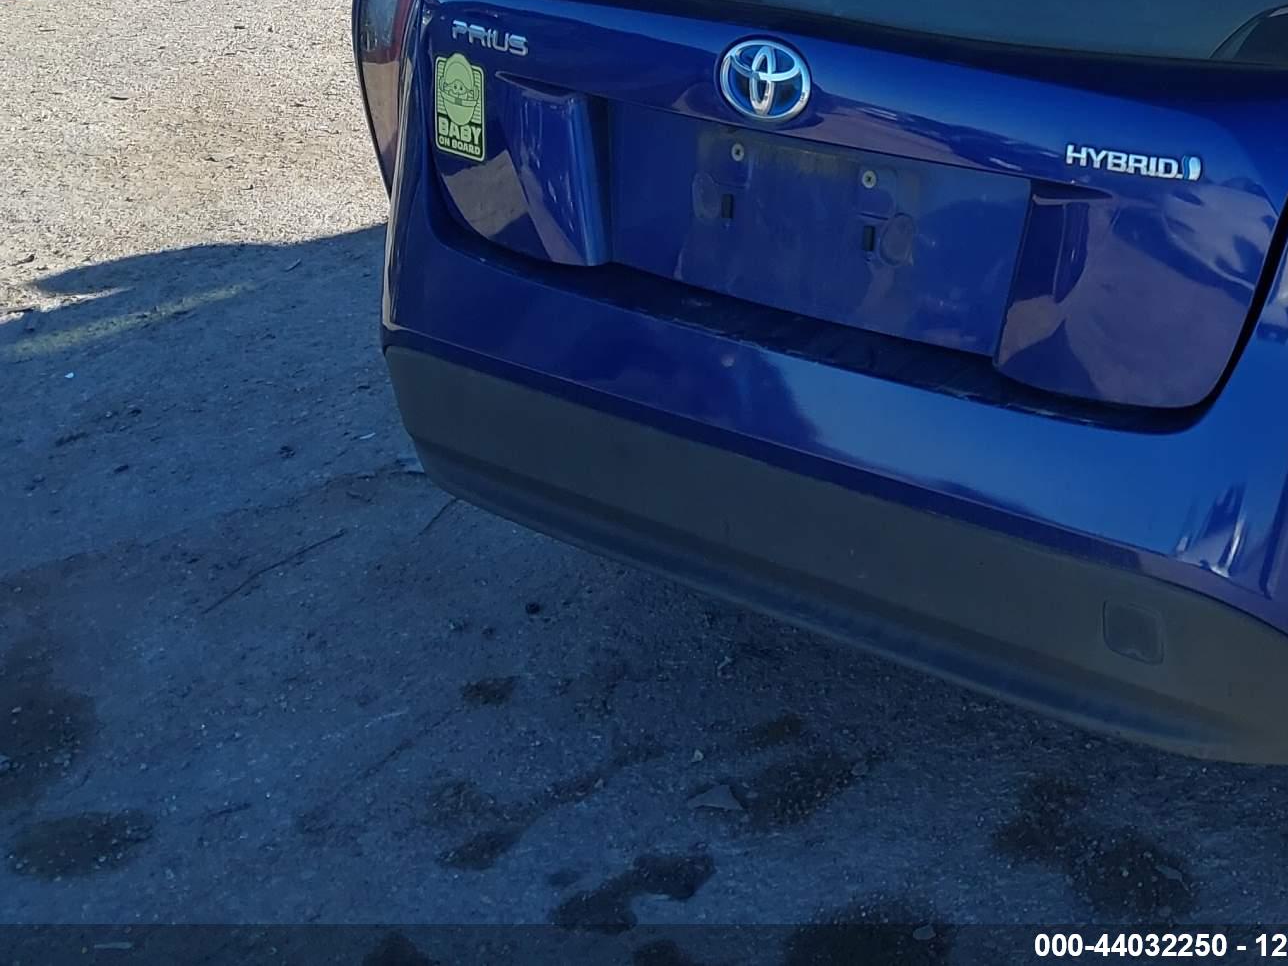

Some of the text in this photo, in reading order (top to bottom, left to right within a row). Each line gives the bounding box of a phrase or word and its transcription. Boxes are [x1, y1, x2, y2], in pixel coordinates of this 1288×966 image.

[452, 19, 529, 56] PRIUS
[438, 116, 482, 145] BABY
[438, 135, 481, 155] ON BOARD
